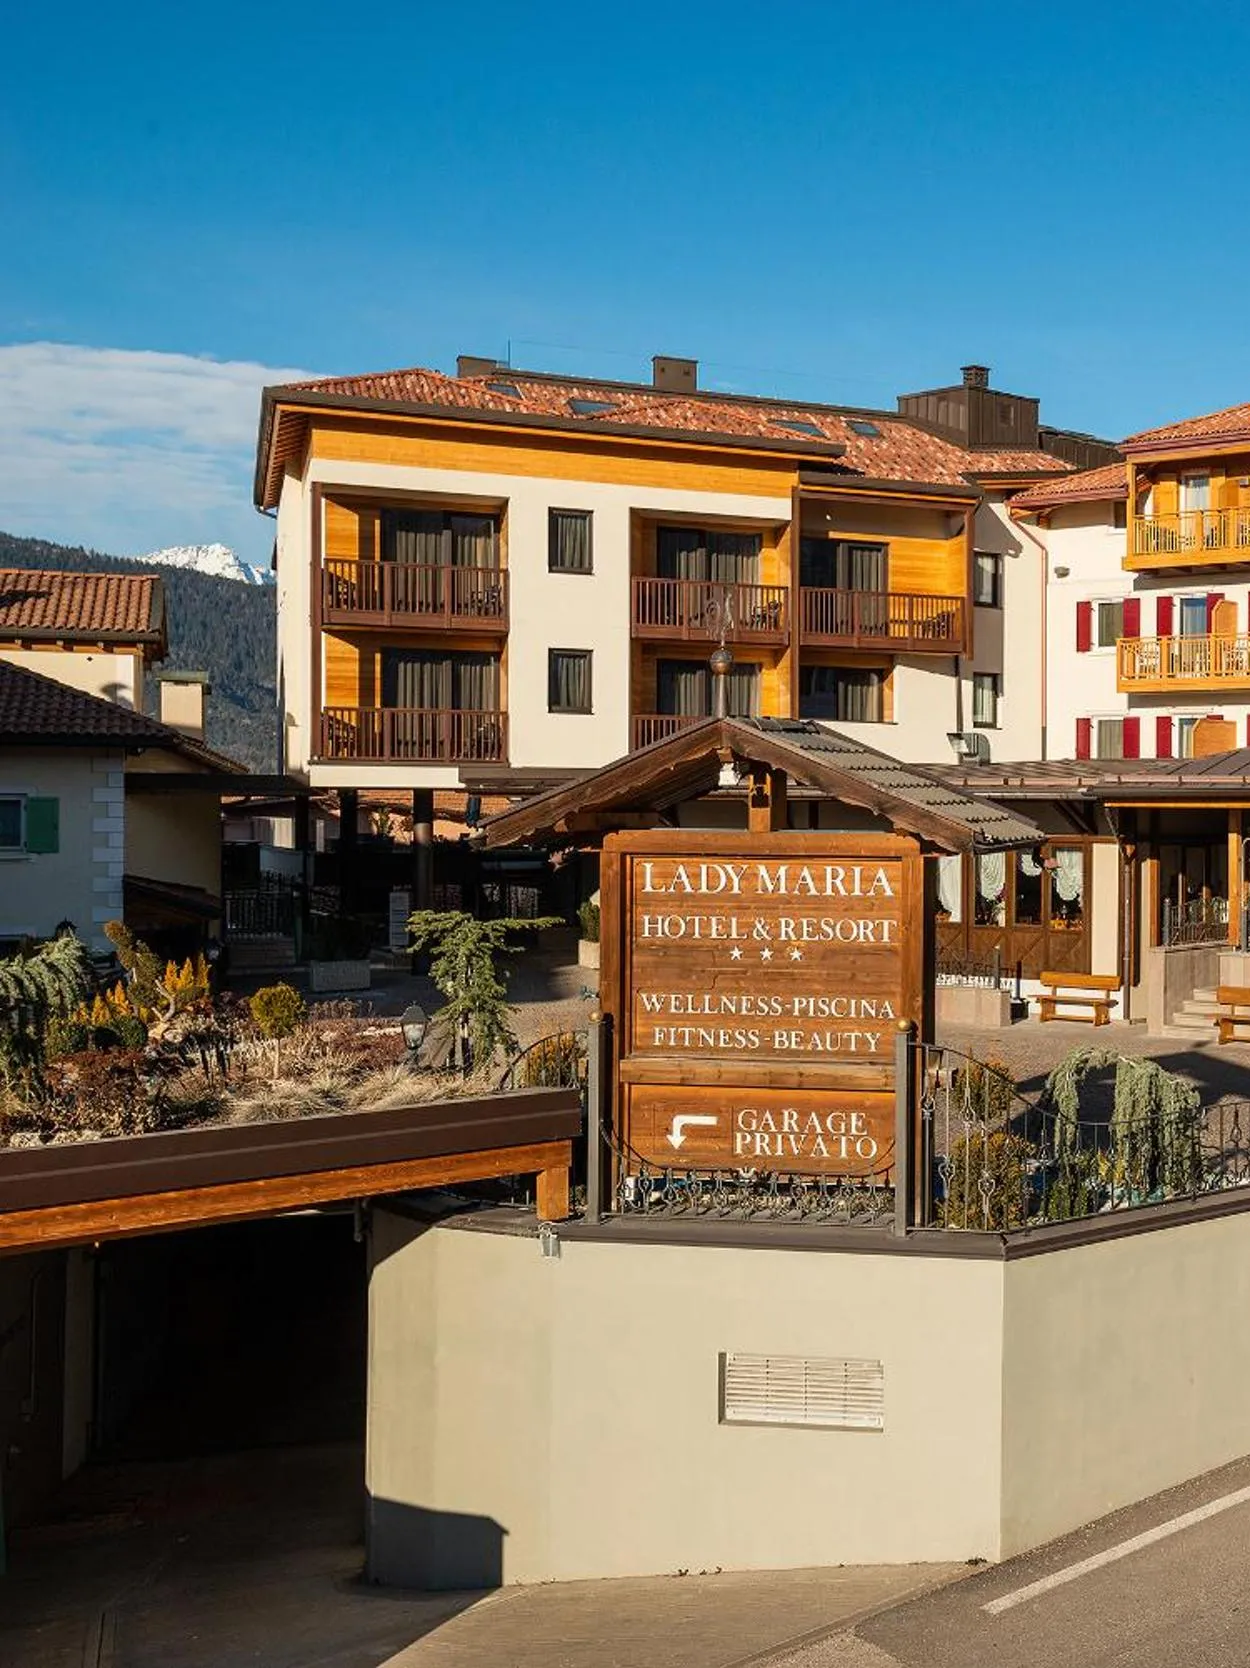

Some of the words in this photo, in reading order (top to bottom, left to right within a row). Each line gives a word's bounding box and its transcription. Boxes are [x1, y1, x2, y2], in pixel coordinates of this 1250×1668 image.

[641, 862, 748, 895] LADY
[756, 864, 895, 897] MARIA
[641, 914, 749, 940] HOTEL
[752, 917, 773, 941] &
[779, 917, 898, 943] RESORT
[737, 1108, 868, 1136] GARAGE
[735, 1132, 878, 1160] PRIVATO
